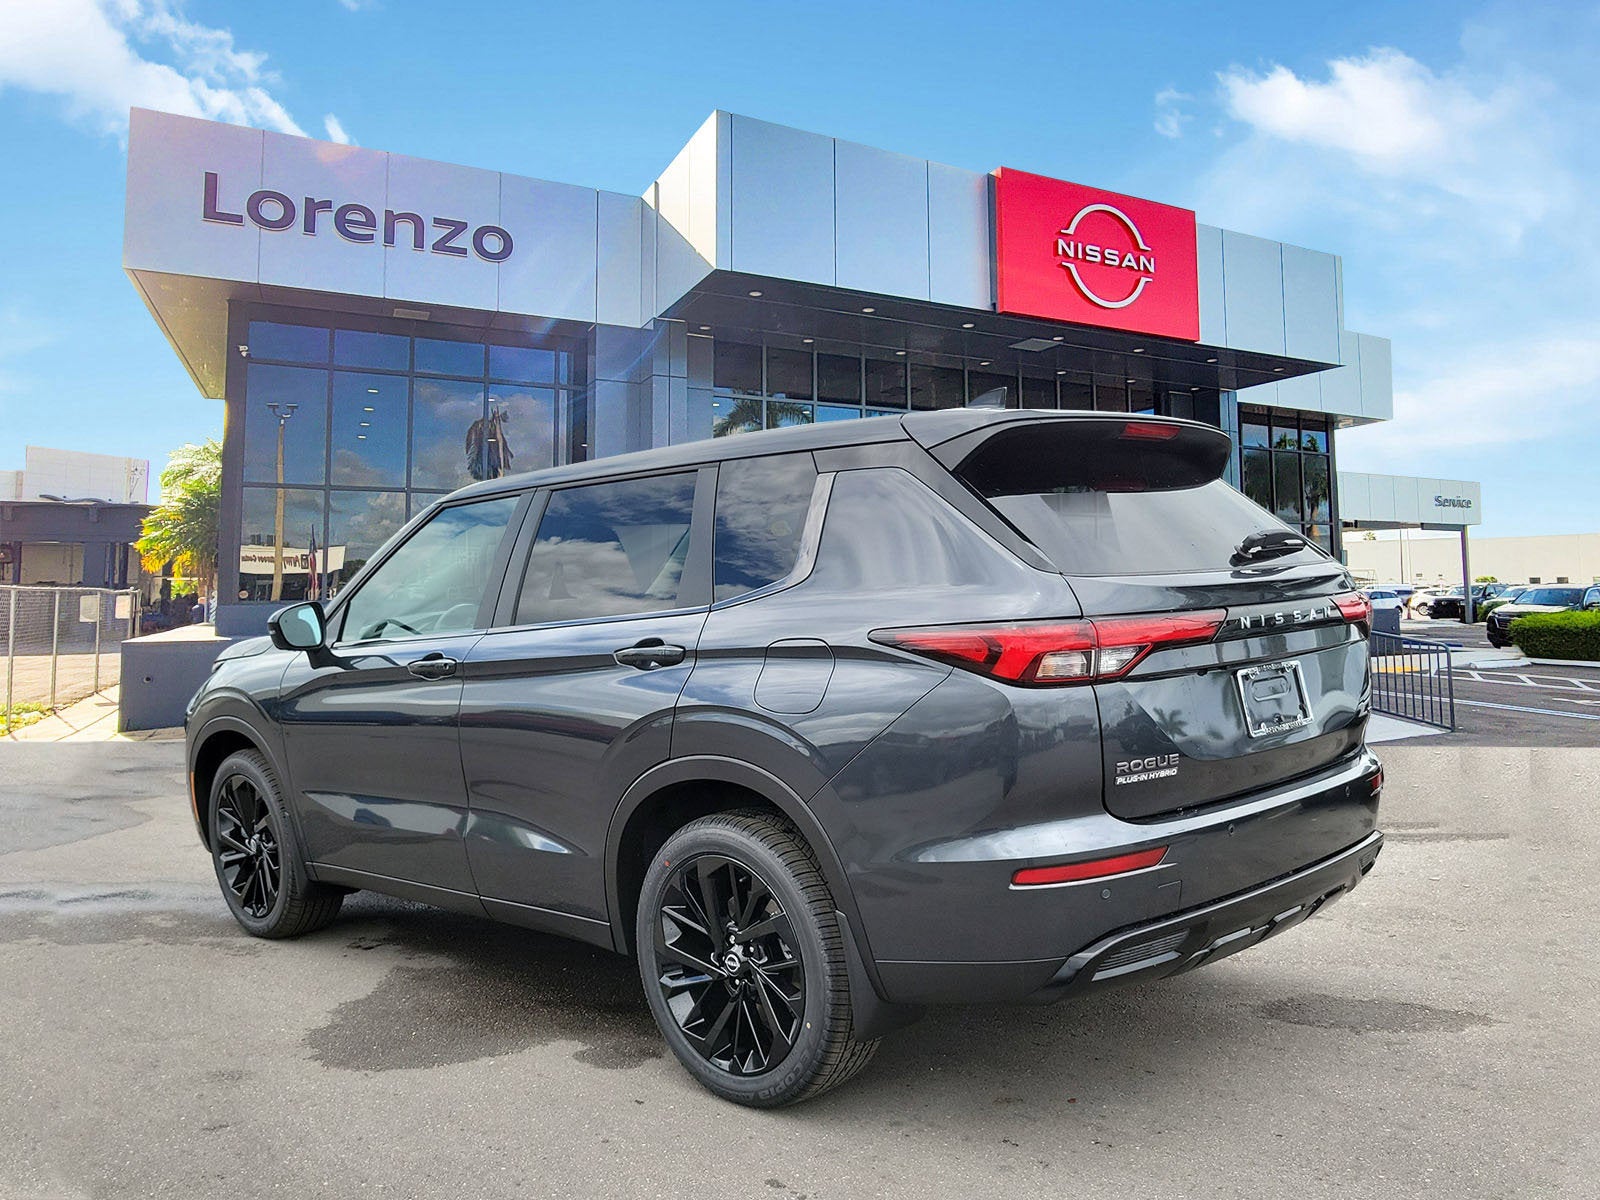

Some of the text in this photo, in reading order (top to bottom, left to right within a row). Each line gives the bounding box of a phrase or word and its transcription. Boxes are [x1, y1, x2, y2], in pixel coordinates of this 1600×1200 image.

[202, 171, 514, 262] Lorenzo
[1057, 238, 1155, 273] NISSAN
[1434, 495, 1472, 508] Service
[1239, 606, 1331, 629] NISSAN
[1116, 753, 1179, 774] ROGUE
[1116, 767, 1178, 785] PLUG-IN HYBRID
